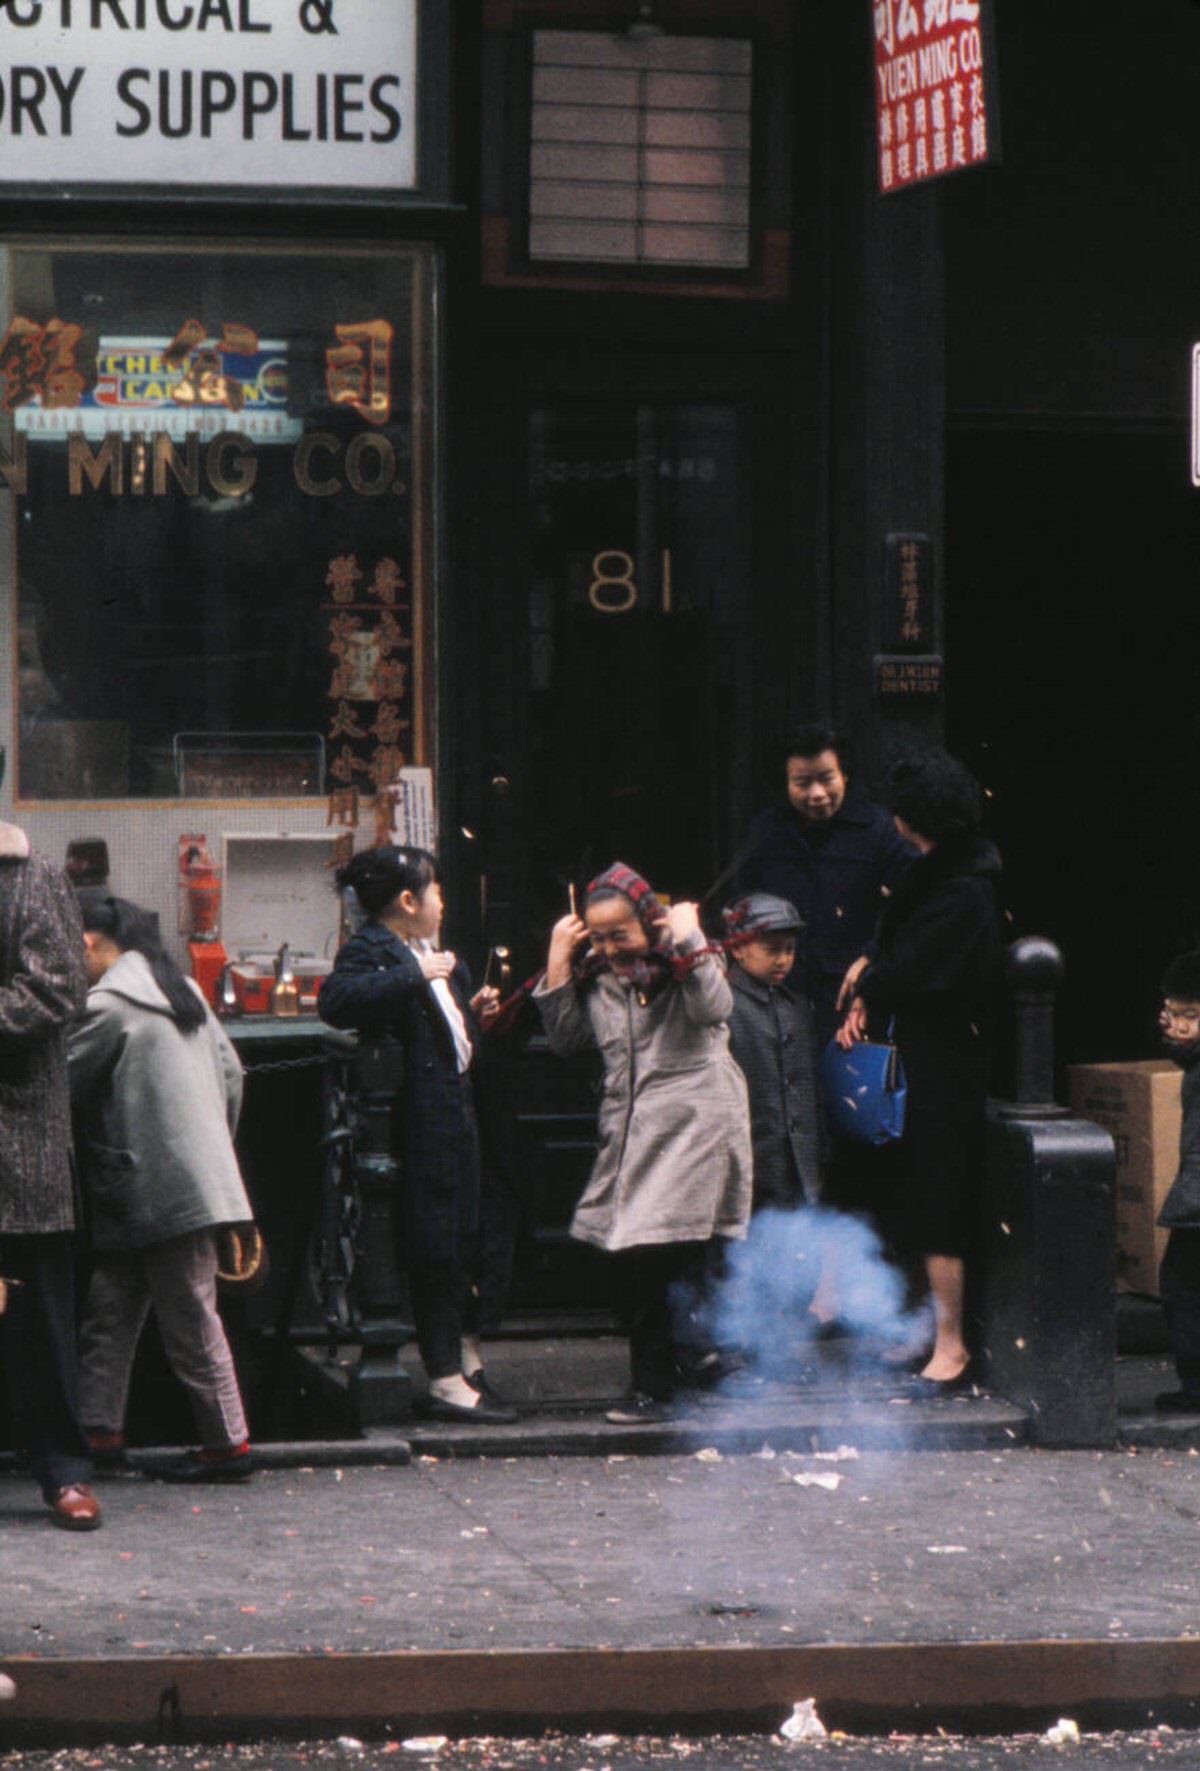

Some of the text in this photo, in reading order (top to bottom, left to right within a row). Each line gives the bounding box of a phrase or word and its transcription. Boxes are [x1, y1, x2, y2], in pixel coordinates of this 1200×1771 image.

[877, 50, 918, 104] YUEN
[918, 35, 958, 90] MING
[0, 66, 402, 143] RY SUPPLIES
[67, 430, 259, 497] MING
[292, 432, 407, 497] CO.
[589, 549, 671, 613] 81
